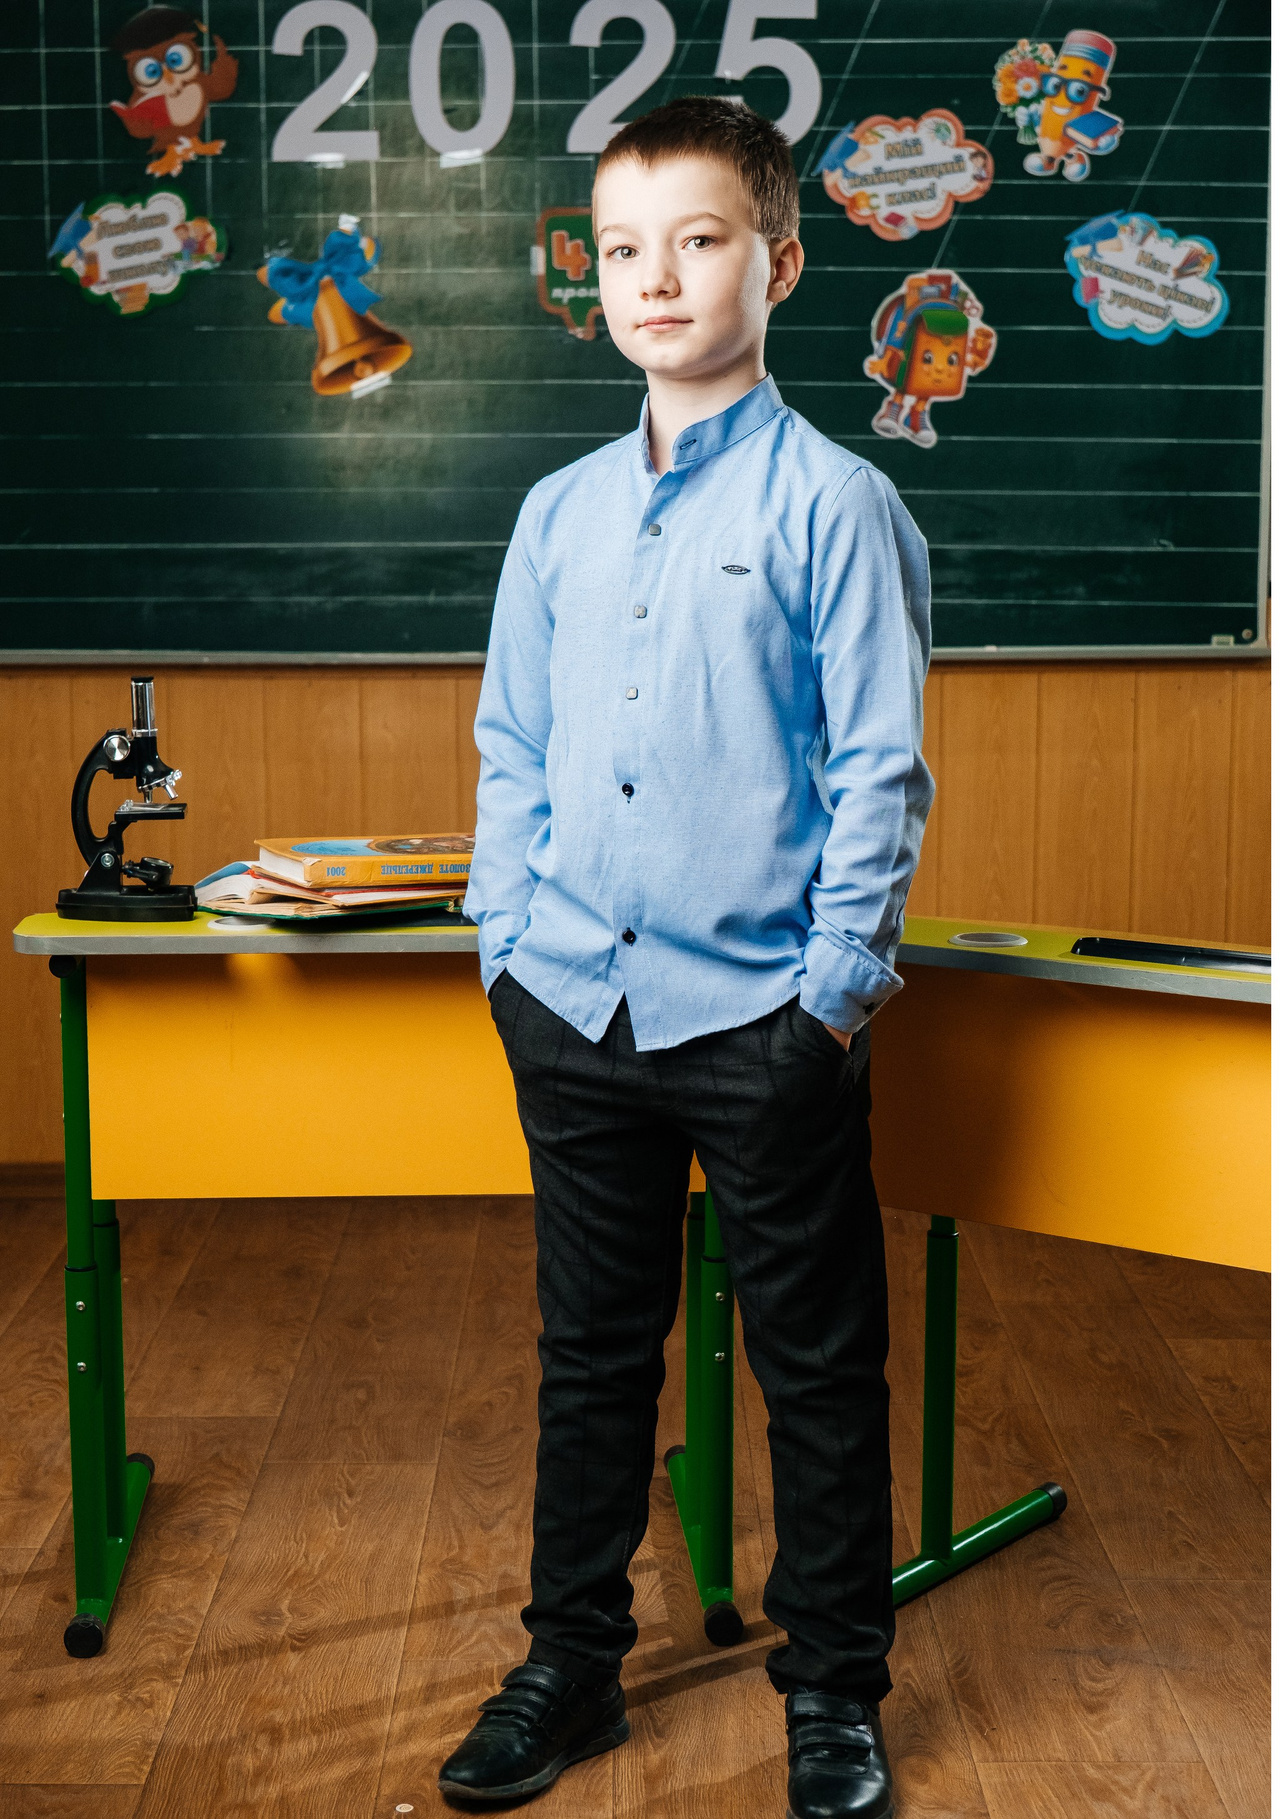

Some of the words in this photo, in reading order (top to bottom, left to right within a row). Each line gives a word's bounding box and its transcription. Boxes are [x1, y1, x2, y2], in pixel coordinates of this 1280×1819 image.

[271, 0, 823, 163] 2025
[326, 866, 347, 877] 2001
[381, 862, 433, 875] ДЖЕРЕЛЬЦЕ
